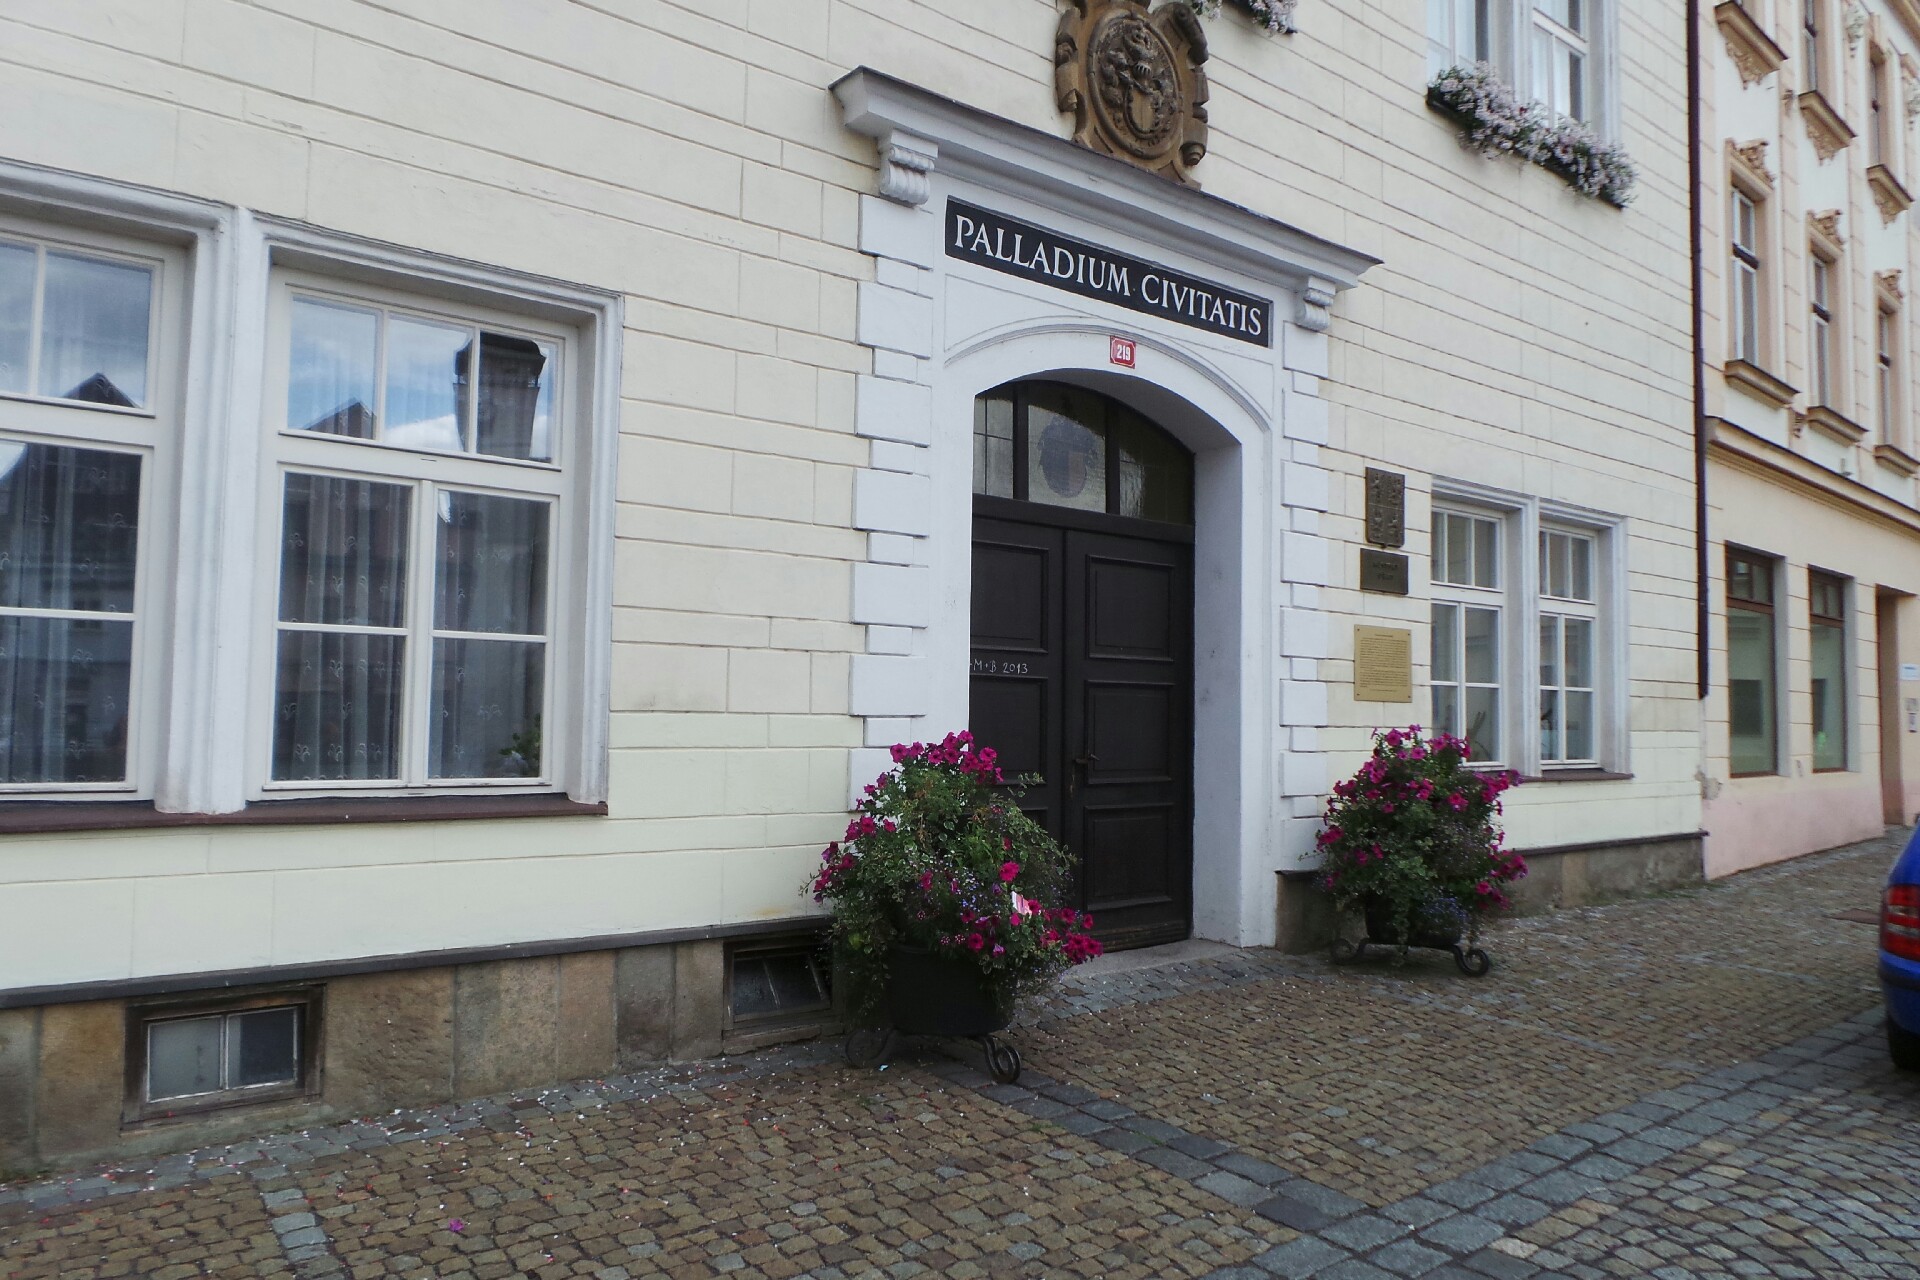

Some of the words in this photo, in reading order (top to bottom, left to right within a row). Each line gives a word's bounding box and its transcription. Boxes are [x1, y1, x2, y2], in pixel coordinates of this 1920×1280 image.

[955, 215, 1131, 296] PALLADIUM
[1141, 274, 1262, 336] CIVITATIS
[1116, 344, 1131, 361] 219
[1003, 662, 1028, 675] 2013
